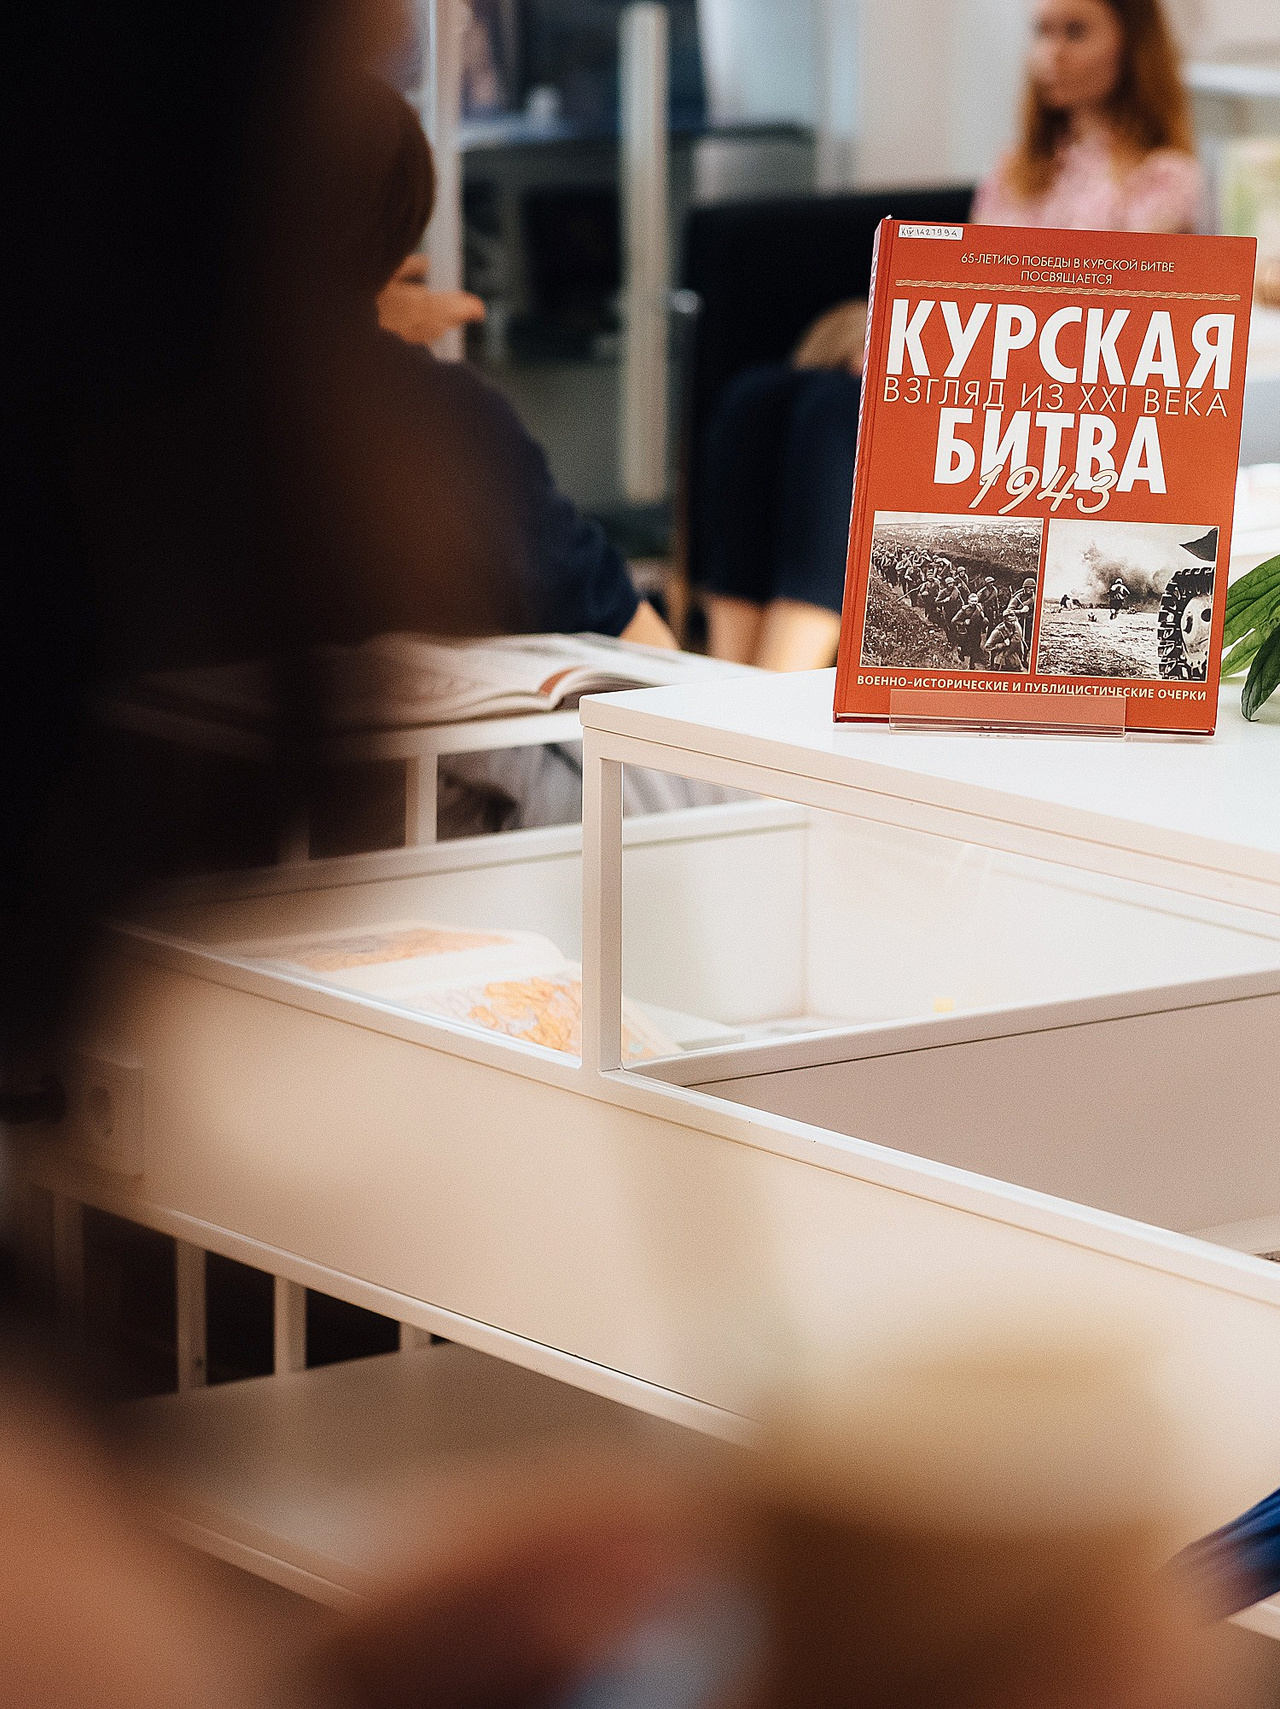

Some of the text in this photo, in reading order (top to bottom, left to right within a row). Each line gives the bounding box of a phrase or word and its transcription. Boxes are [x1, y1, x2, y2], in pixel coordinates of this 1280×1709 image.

[961, 252, 1175, 273] 65-ЛЕТИЮ ПОБЕДЫ В КУРСКОЙ БИТВЕ
[1020, 270, 1113, 285] ПОСВЯЩАЕТСЯ
[885, 298, 1235, 390] КУРСКАЯ
[883, 376, 1005, 411] ВЗГЛЯД
[1021, 383, 1064, 410] ИЗ
[1143, 388, 1228, 417] ВЕКА
[933, 407, 1167, 494] БИТВА
[968, 464, 1119, 514] 1943
[857, 675, 1206, 701] ВОЕННО-ИСТОРИЧЕСКИЕ И ПУБЛИЦИСТИЧЕСКИЕ ОЧЕРКИ
